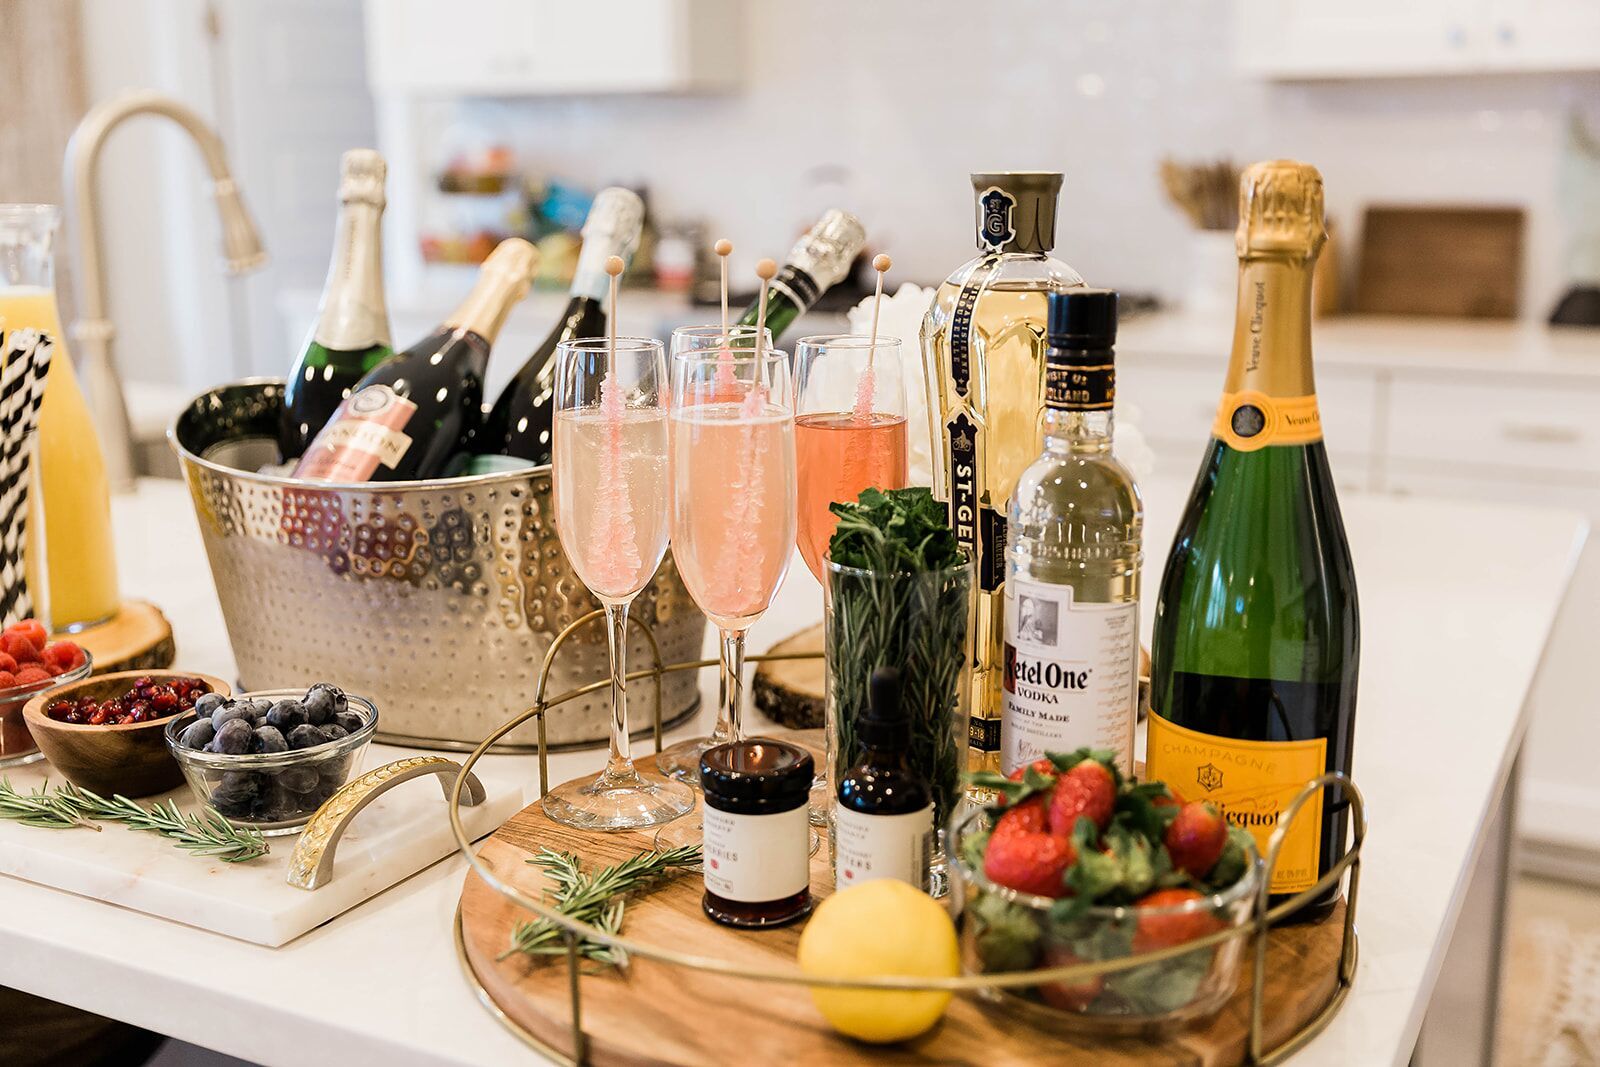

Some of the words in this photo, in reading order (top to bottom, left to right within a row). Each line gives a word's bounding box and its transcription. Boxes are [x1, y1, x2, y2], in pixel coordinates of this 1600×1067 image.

[986, 213, 1005, 237] G
[953, 292, 968, 364] BOUTEILLE
[961, 303, 974, 375] PARISIENNE
[1046, 387, 1090, 403] OLLAND
[1045, 662, 1088, 690] One
[1017, 686, 1059, 705] VODKA
[1008, 701, 1036, 718] FAMILY
[1039, 710, 1070, 724] MADE
[1162, 743, 1281, 775] CHAMPAGNE
